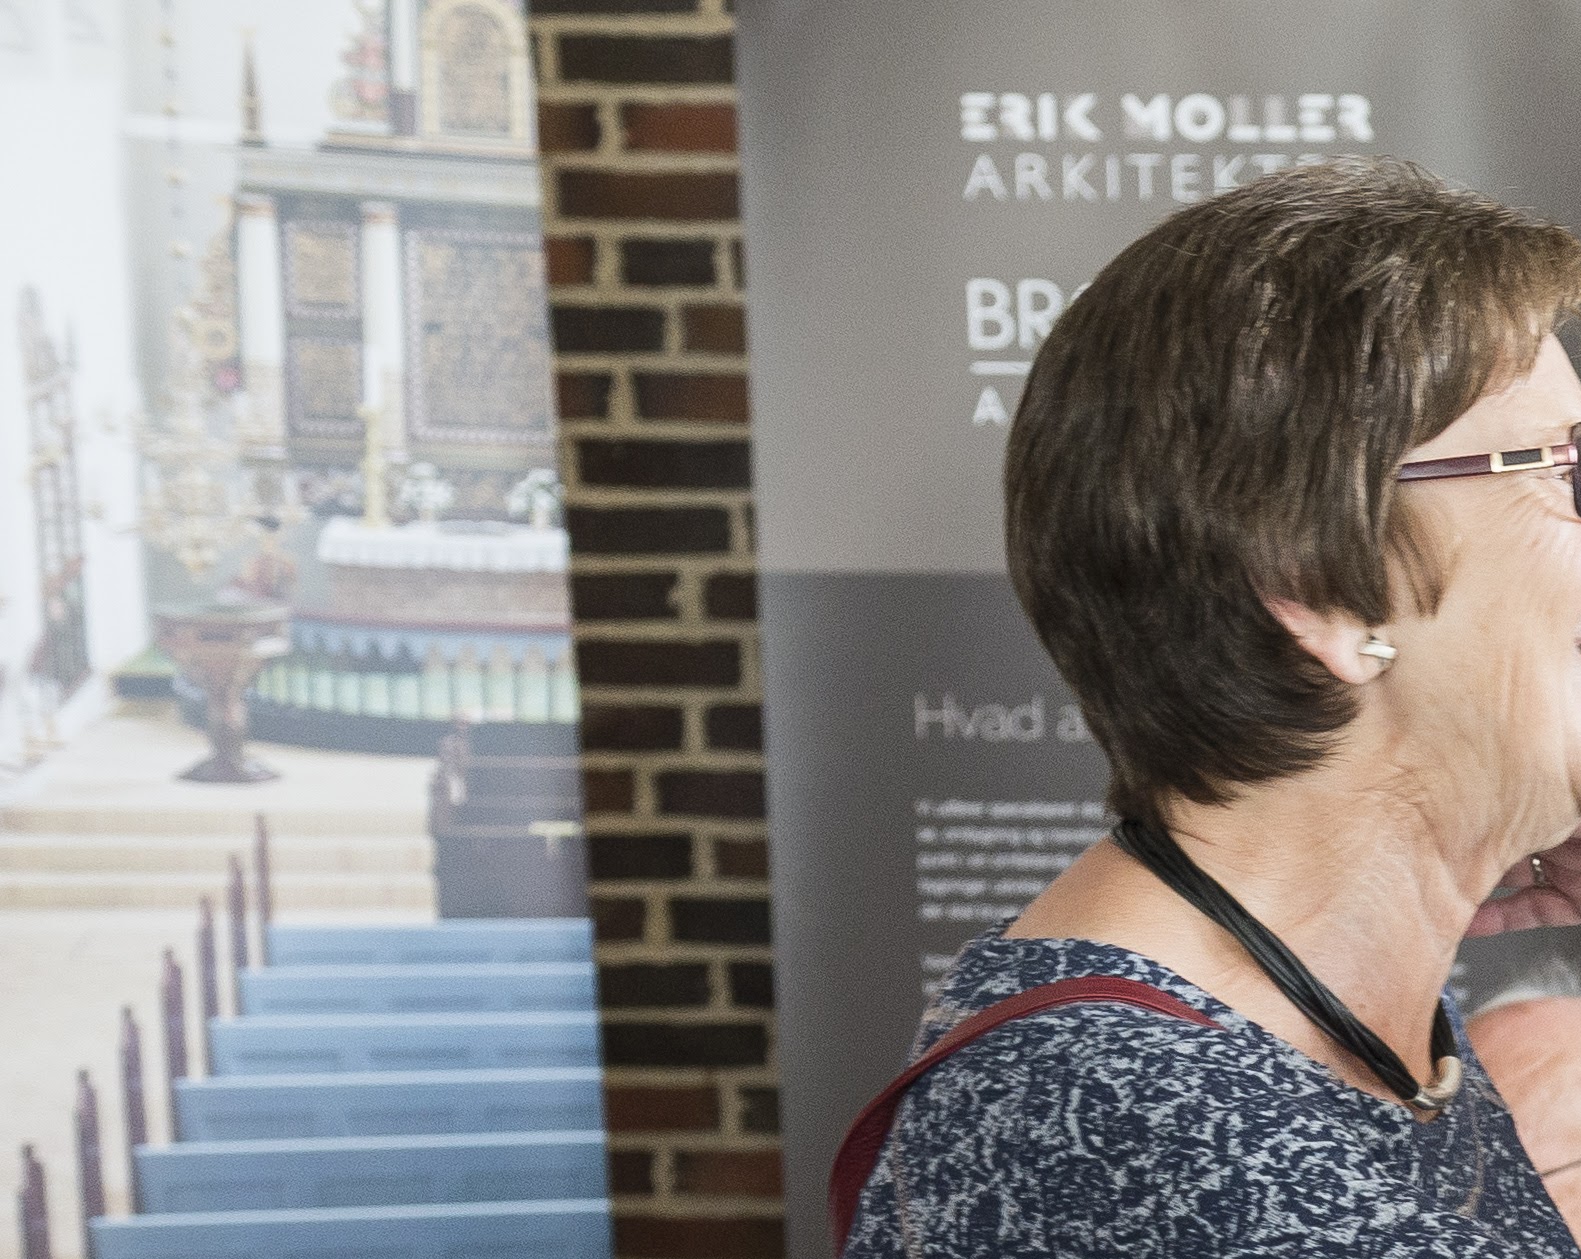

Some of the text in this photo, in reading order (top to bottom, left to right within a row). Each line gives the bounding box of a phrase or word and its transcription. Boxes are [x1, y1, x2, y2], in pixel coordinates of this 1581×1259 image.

[960, 91, 1102, 142] ERIK
[965, 278, 1094, 351] BR
[914, 692, 1046, 742] Hvad
